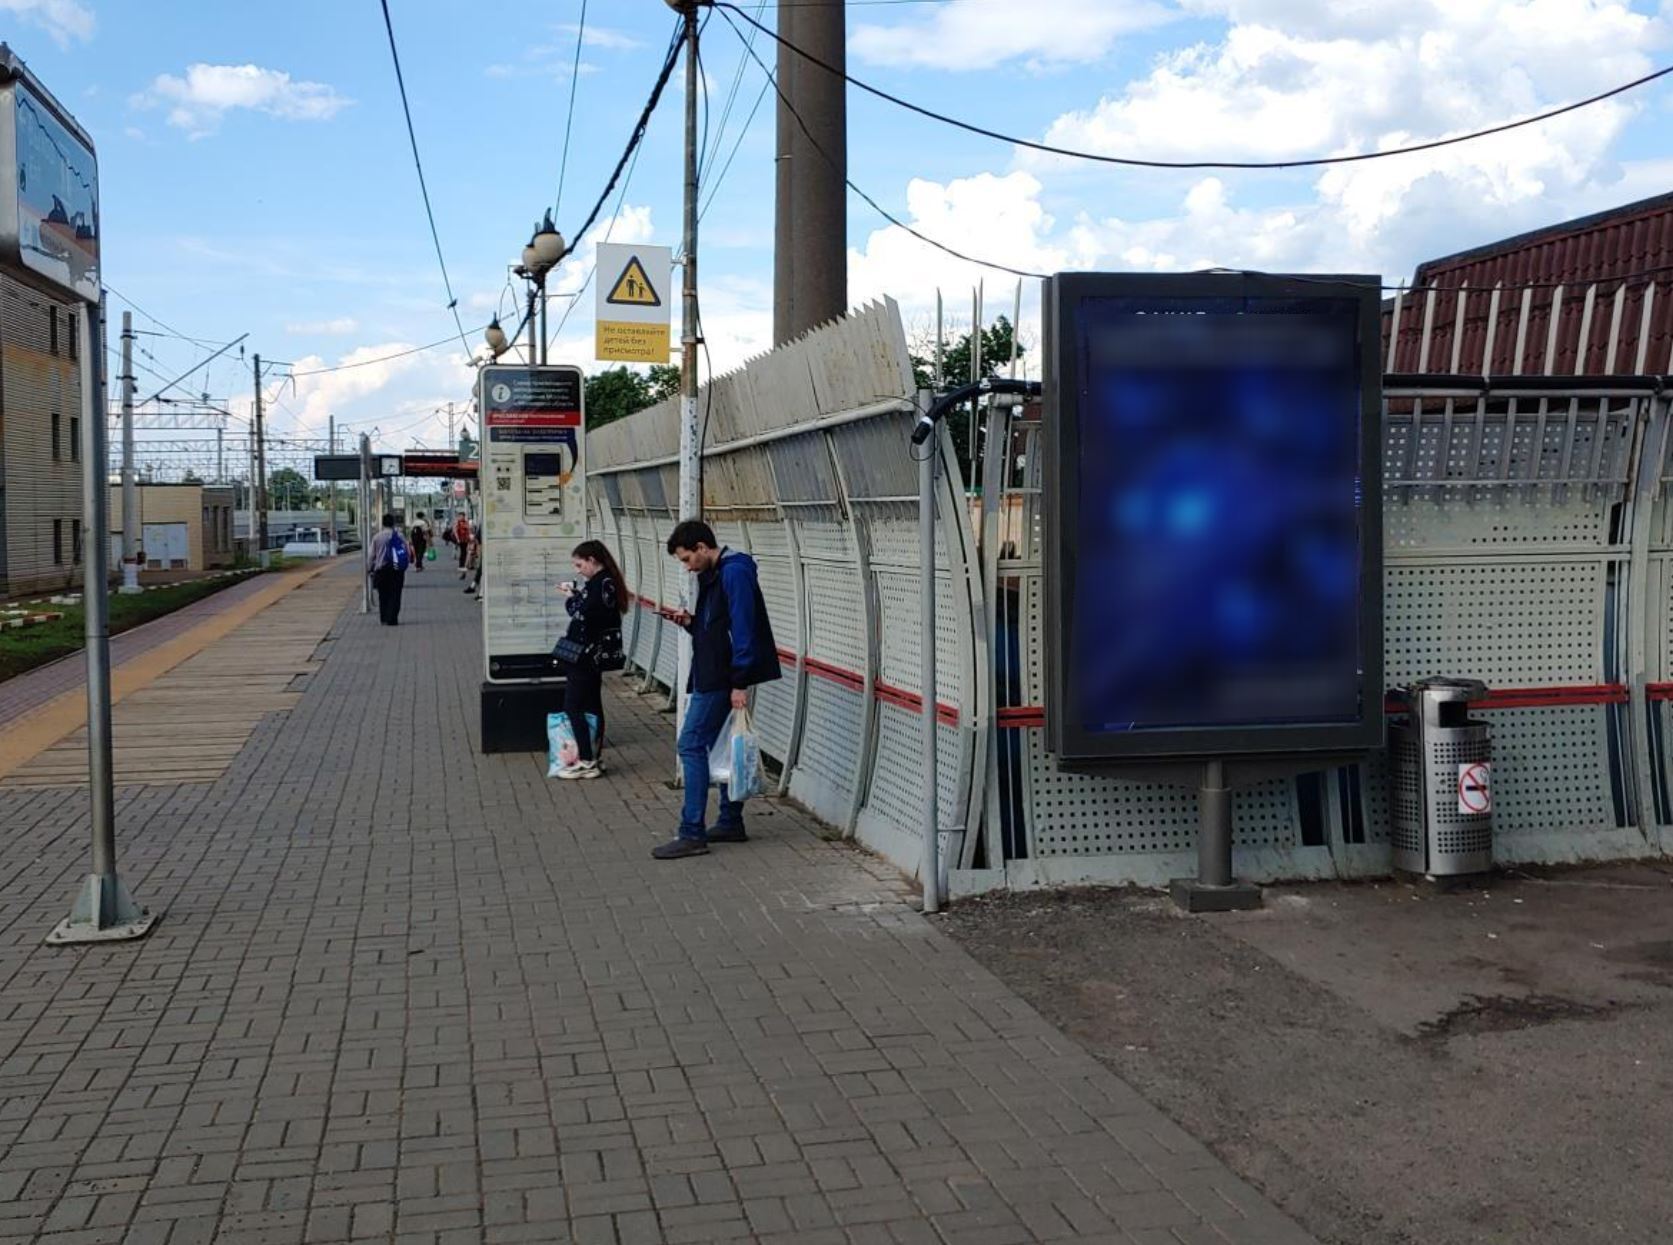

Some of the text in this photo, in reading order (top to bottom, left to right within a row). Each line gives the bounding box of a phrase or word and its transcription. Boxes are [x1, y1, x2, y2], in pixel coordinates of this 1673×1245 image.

[603, 325, 666, 336] Не оставляйте
[603, 335, 647, 346] детей без
[602, 346, 655, 357] присмотра!
[468, 443, 479, 459] 2
